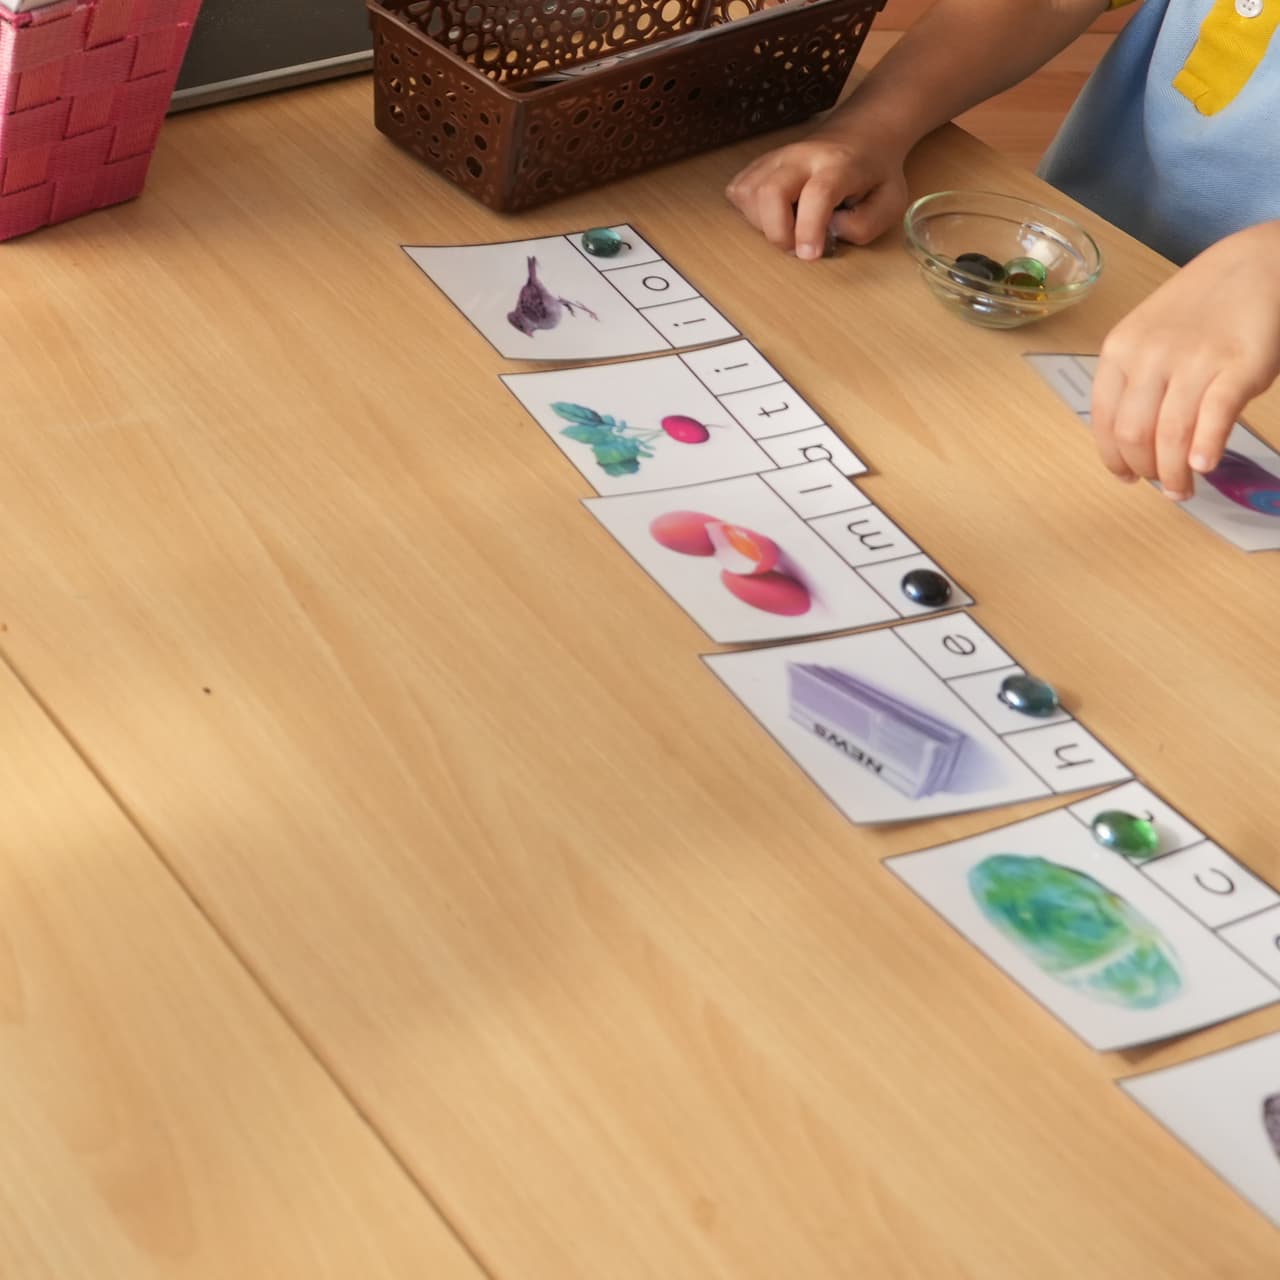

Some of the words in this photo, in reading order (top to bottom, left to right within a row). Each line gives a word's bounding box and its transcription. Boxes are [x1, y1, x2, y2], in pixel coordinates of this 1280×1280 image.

[757, 401, 790, 419] t
[847, 517, 895, 552] m
[942, 634, 976, 657] e
[813, 722, 885, 776] NEWS
[1194, 869, 1236, 896] c
